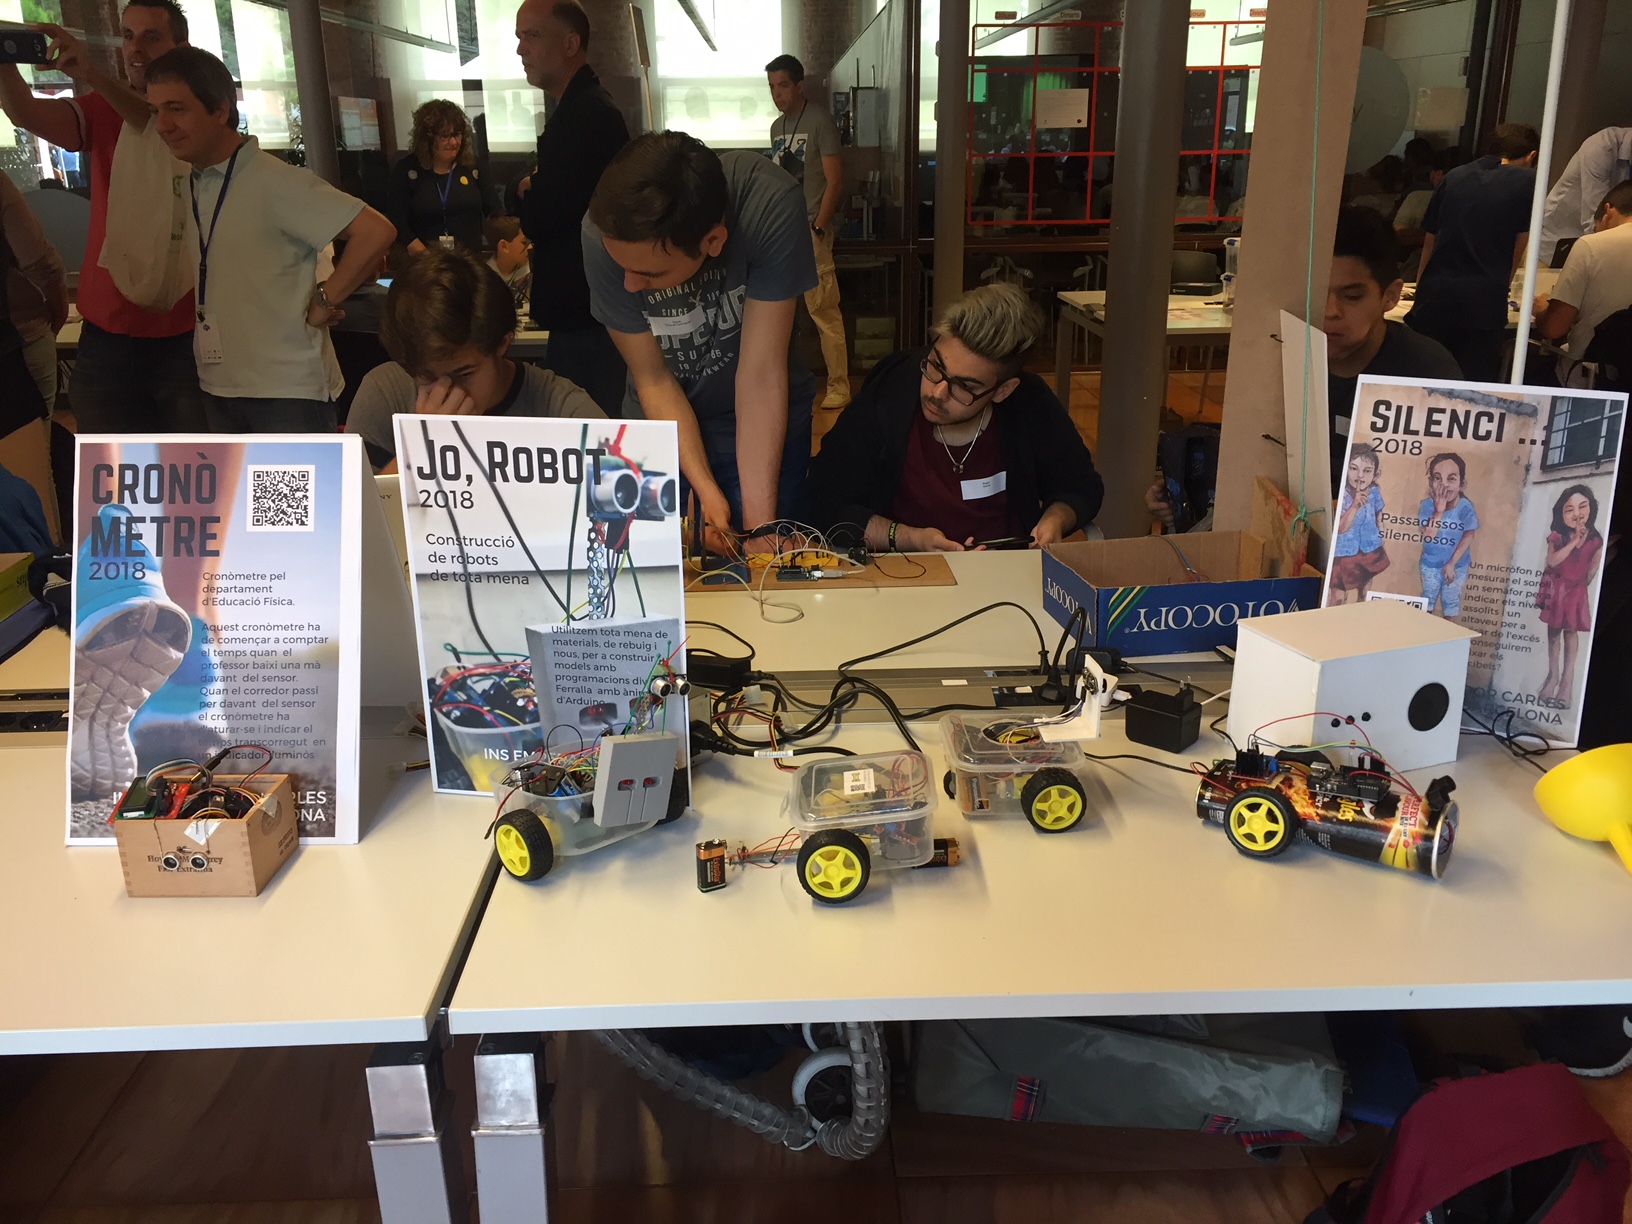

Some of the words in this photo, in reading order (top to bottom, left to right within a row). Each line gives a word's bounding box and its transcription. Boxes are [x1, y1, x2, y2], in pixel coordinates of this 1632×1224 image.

[647, 281, 696, 305] ORIGINAL
[661, 307, 688, 317] SINCE
[1371, 437, 1423, 456] 2018
[92, 452, 217, 505] CRONÒ
[419, 489, 474, 509] 2018
[1381, 512, 1466, 532] Passadissos
[90, 516, 221, 557] METRE
[425, 533, 515, 548] Construcció
[1378, 529, 1456, 547] silenciosos
[428, 551, 447, 564] de
[450, 552, 499, 566] robots
[89, 562, 146, 580] 2018
[1469, 562, 1483, 570] Un
[1486, 563, 1533, 576] micròfon
[202, 572, 267, 581] Cronòmetre
[269, 572, 286, 582] pel
[430, 568, 448, 582] de
[452, 570, 483, 583] tota
[487, 574, 530, 585] mena
[1468, 573, 1510, 583] mesurar
[202, 585, 273, 594] departament
[1482, 585, 1523, 596] semàfor
[202, 597, 261, 606] d'Educació
[263, 597, 295, 606] Física.
[1464, 593, 1500, 604] indicar
[1462, 605, 1499, 616] assolits
[201, 623, 239, 633] Aquest
[242, 623, 305, 631] cronòmetre
[308, 623, 321, 631] ha
[1461, 616, 1498, 626] altaveu
[1501, 621, 1518, 629] per
[551, 625, 598, 636] Utilitzem
[600, 628, 620, 637] tota
[655, 629, 669, 639] de
[1491, 629, 1504, 638] de
[1507, 632, 1540, 643] l'excés
[201, 636, 215, 644] de
[217, 637, 271, 646] començar
[282, 636, 329, 645] comptar
[552, 637, 602, 648] materials,
[603, 639, 616, 648] de
[619, 640, 652, 651] rebuig
[1471, 639, 1532, 653] onseguirem
[201, 648, 210, 657] el
[213, 649, 247, 658] temps
[249, 650, 277, 658] quan
[282, 648, 292, 656] el
[553, 650, 580, 660] nous,
[582, 652, 598, 661] per
[609, 652, 655, 662] construir
[201, 661, 249, 671] professor
[252, 661, 278, 670] baixi
[281, 662, 300, 670] una
[304, 661, 321, 669] mà
[554, 662, 591, 671] models
[594, 663, 617, 672] amb
[1468, 660, 1501, 671] cibels?
[201, 674, 237, 682] davant
[242, 674, 259, 682] del
[555, 673, 630, 685] programacions
[200, 687, 228, 696] Quan
[231, 687, 241, 695] el
[243, 687, 289, 695] corredor
[292, 686, 319, 696] passi
[556, 685, 592, 695] Ferralla
[598, 688, 621, 696] amb
[199, 701, 217, 709] per
[220, 700, 256, 708] davant
[262, 699, 278, 708] del
[281, 700, 316, 708] sensor
[1501, 690, 1566, 710] CARLES
[199, 712, 208, 720] el
[210, 712, 273, 720] cronòmetre
[277, 712, 290, 720] ha
[199, 725, 255, 734] d'aturar-se
[263, 725, 301, 733] indicar
[303, 725, 313, 733] el
[235, 739, 308, 748] transcorregut
[215, 751, 265, 759] idicador
[484, 748, 510, 761] INS
